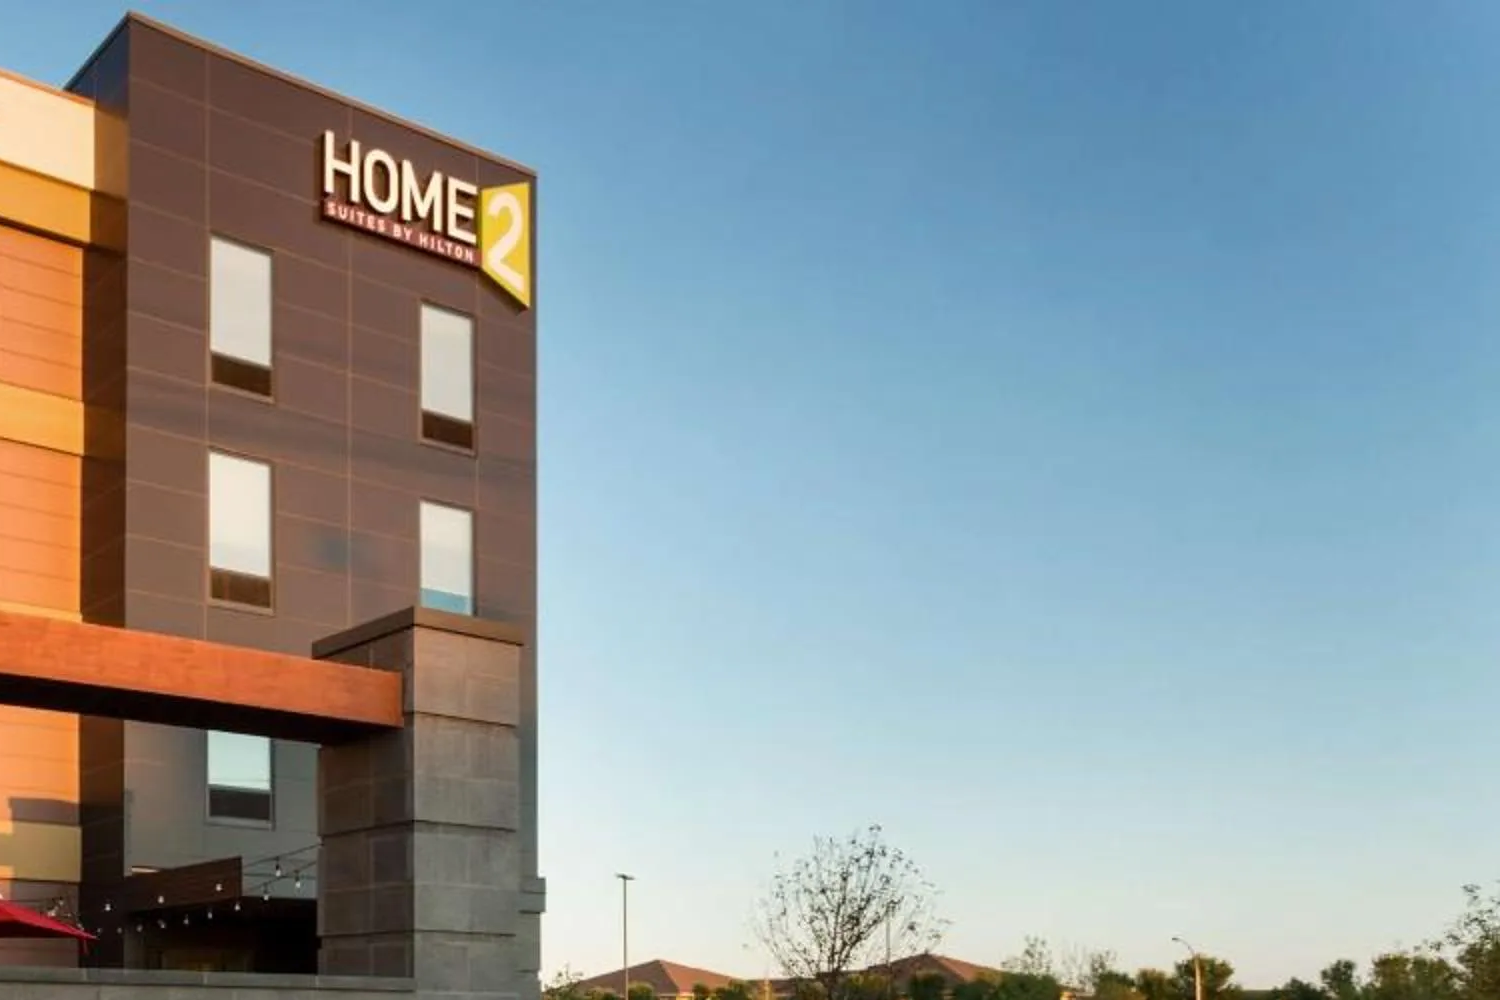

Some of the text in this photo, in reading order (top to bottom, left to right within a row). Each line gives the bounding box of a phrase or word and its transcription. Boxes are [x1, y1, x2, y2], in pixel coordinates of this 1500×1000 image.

[324, 129, 526, 293] HOME 2
[327, 202, 473, 264] SUITES BY HILTON
